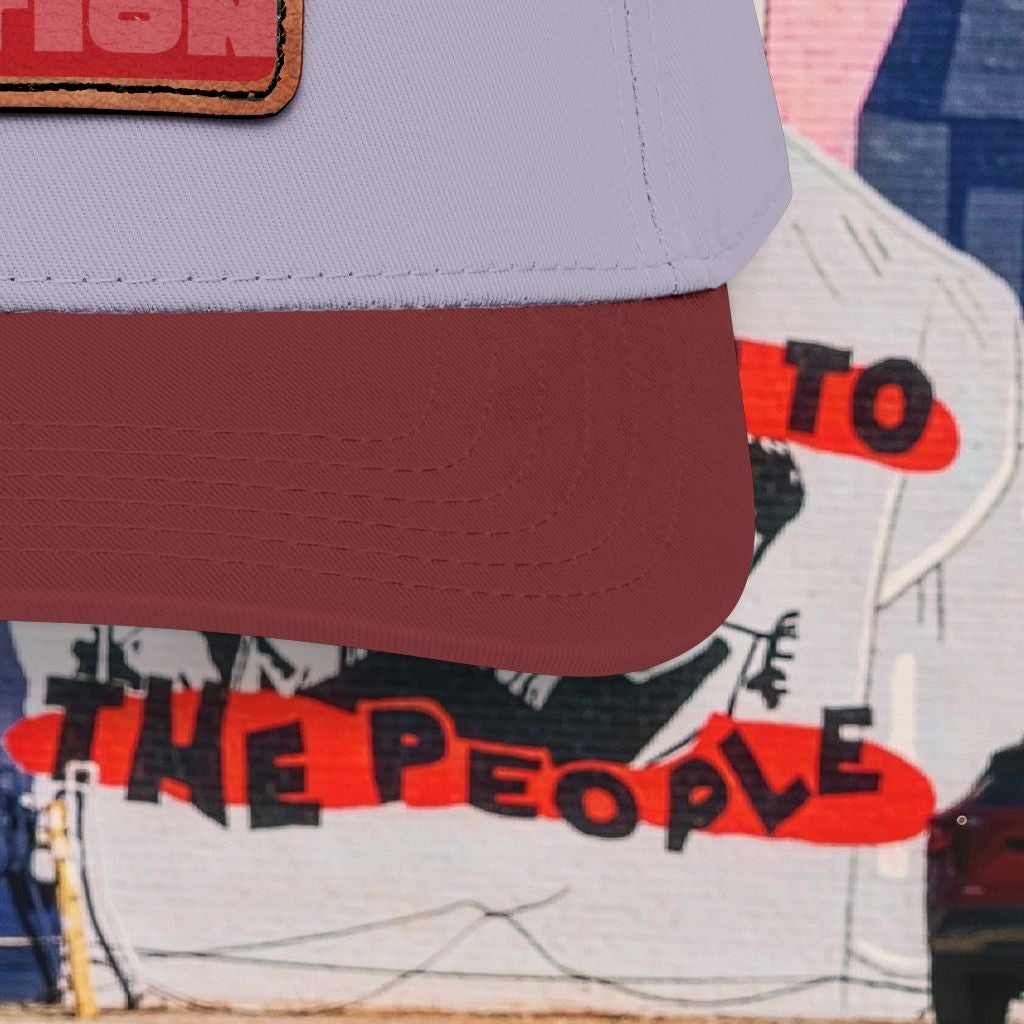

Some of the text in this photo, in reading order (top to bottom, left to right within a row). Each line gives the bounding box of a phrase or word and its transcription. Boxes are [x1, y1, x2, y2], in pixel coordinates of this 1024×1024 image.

[785, 340, 933, 455] TO
[46, 676, 884, 853] THE PEOPLE
